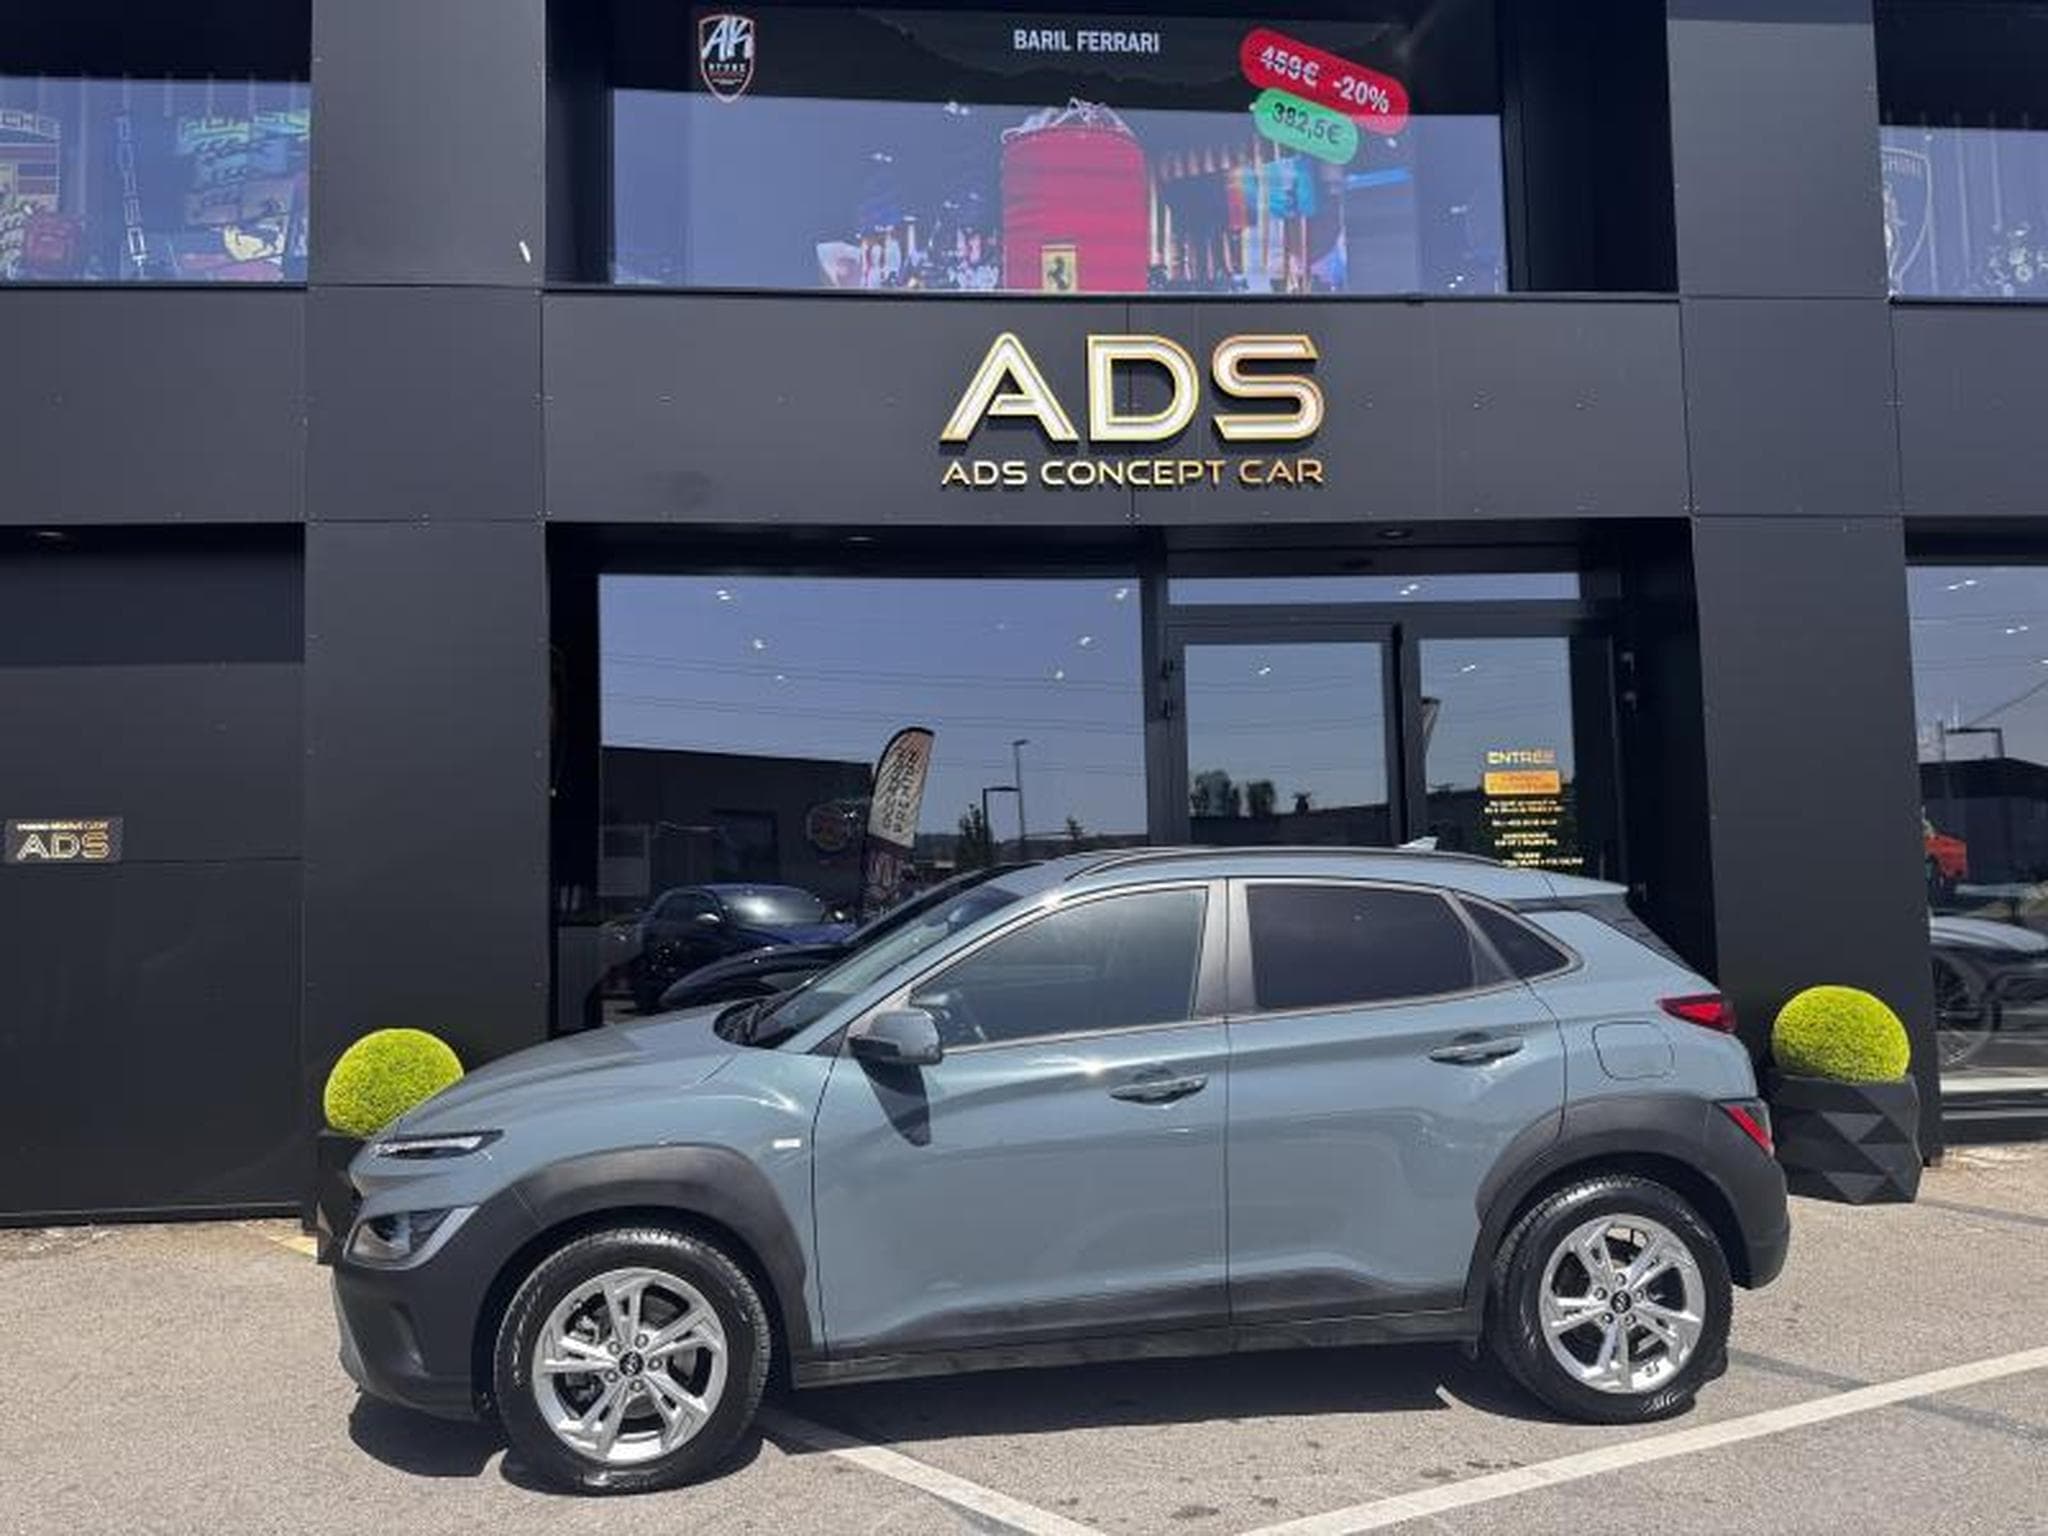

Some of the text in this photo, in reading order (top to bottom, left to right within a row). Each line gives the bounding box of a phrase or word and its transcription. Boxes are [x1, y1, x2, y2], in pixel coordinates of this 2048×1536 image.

[1014, 29, 1160, 54] BARIL FERRARI
[1333, 76, 1390, 114] -20%
[1272, 102, 1343, 144] 382,5€
[940, 332, 1324, 443] ADS
[941, 459, 1324, 487] ADS CONCEPT CAR
[16, 832, 111, 860] ADS
